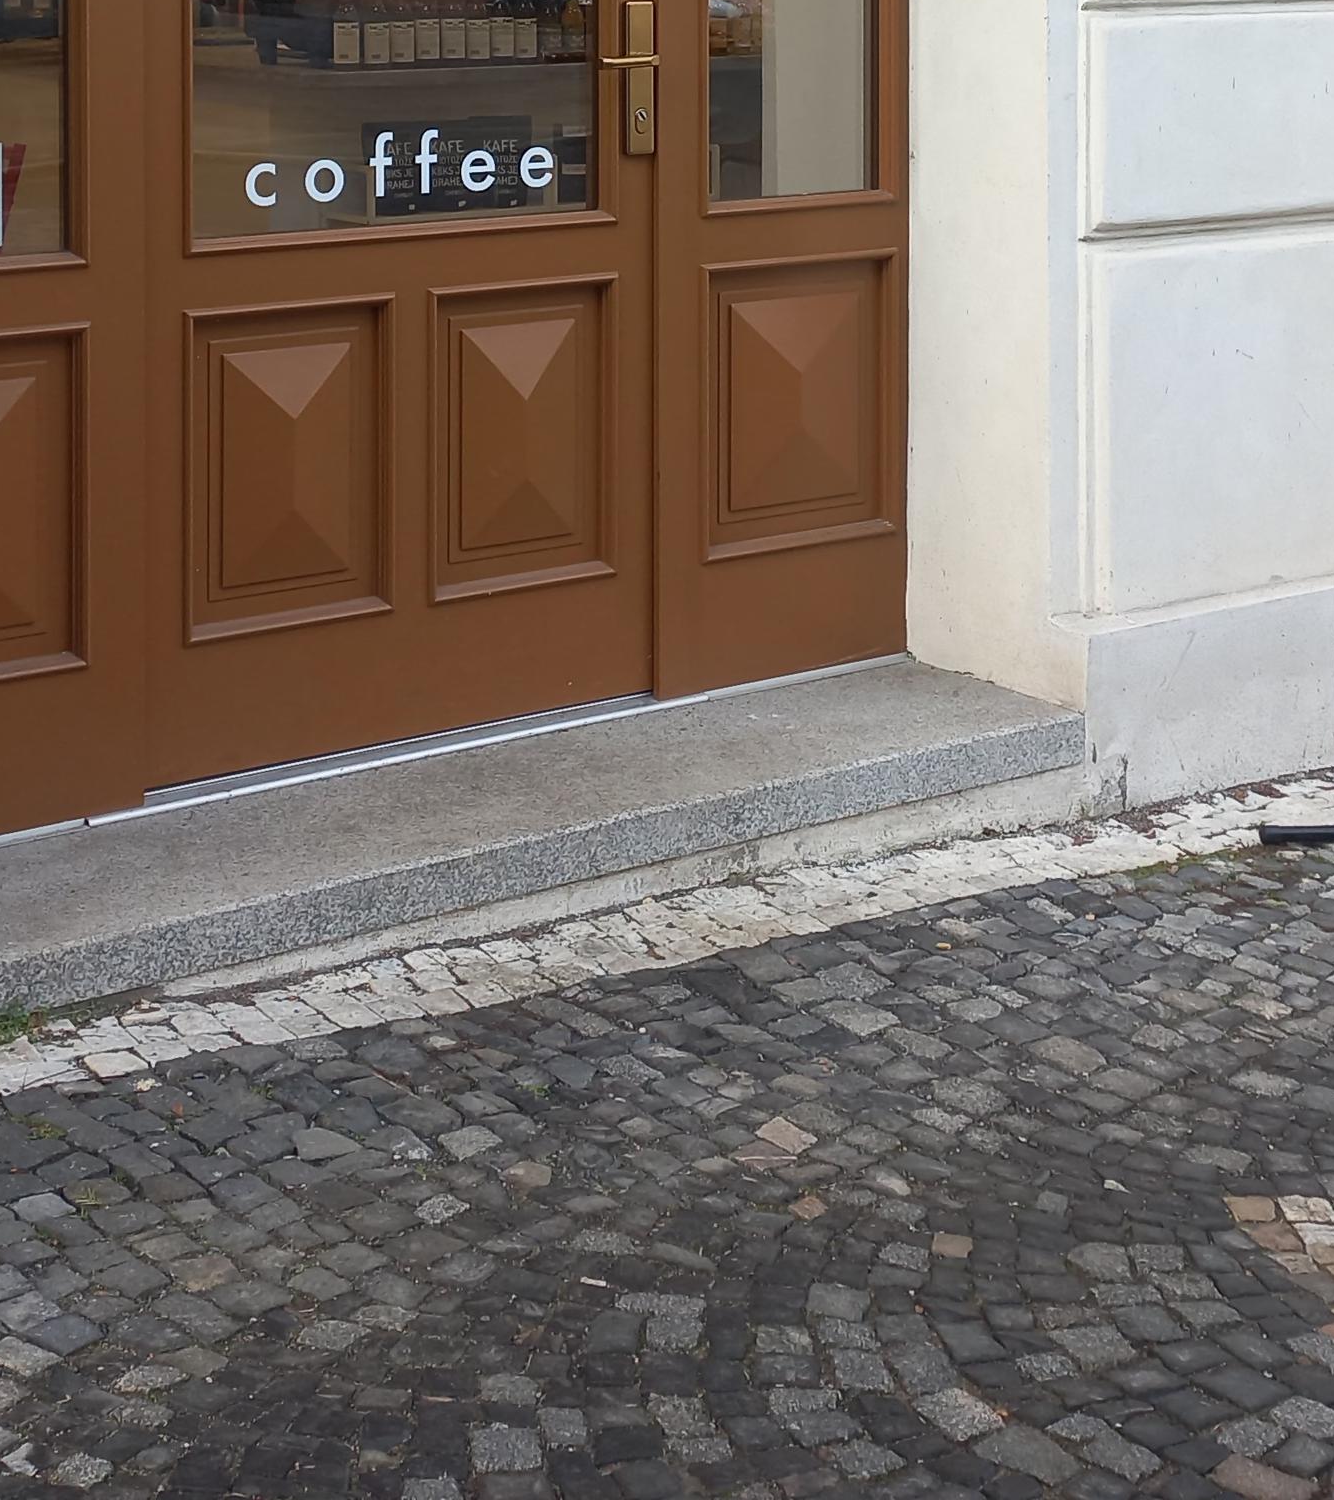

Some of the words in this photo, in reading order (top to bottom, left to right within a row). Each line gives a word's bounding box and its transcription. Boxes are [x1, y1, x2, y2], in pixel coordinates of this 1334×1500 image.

[387, 142, 412, 156] AFE
[483, 139, 518, 153] KAFE
[245, 129, 556, 207] coffee
[387, 179, 415, 190] RAHEJ
[433, 177, 462, 188] DRAHE
